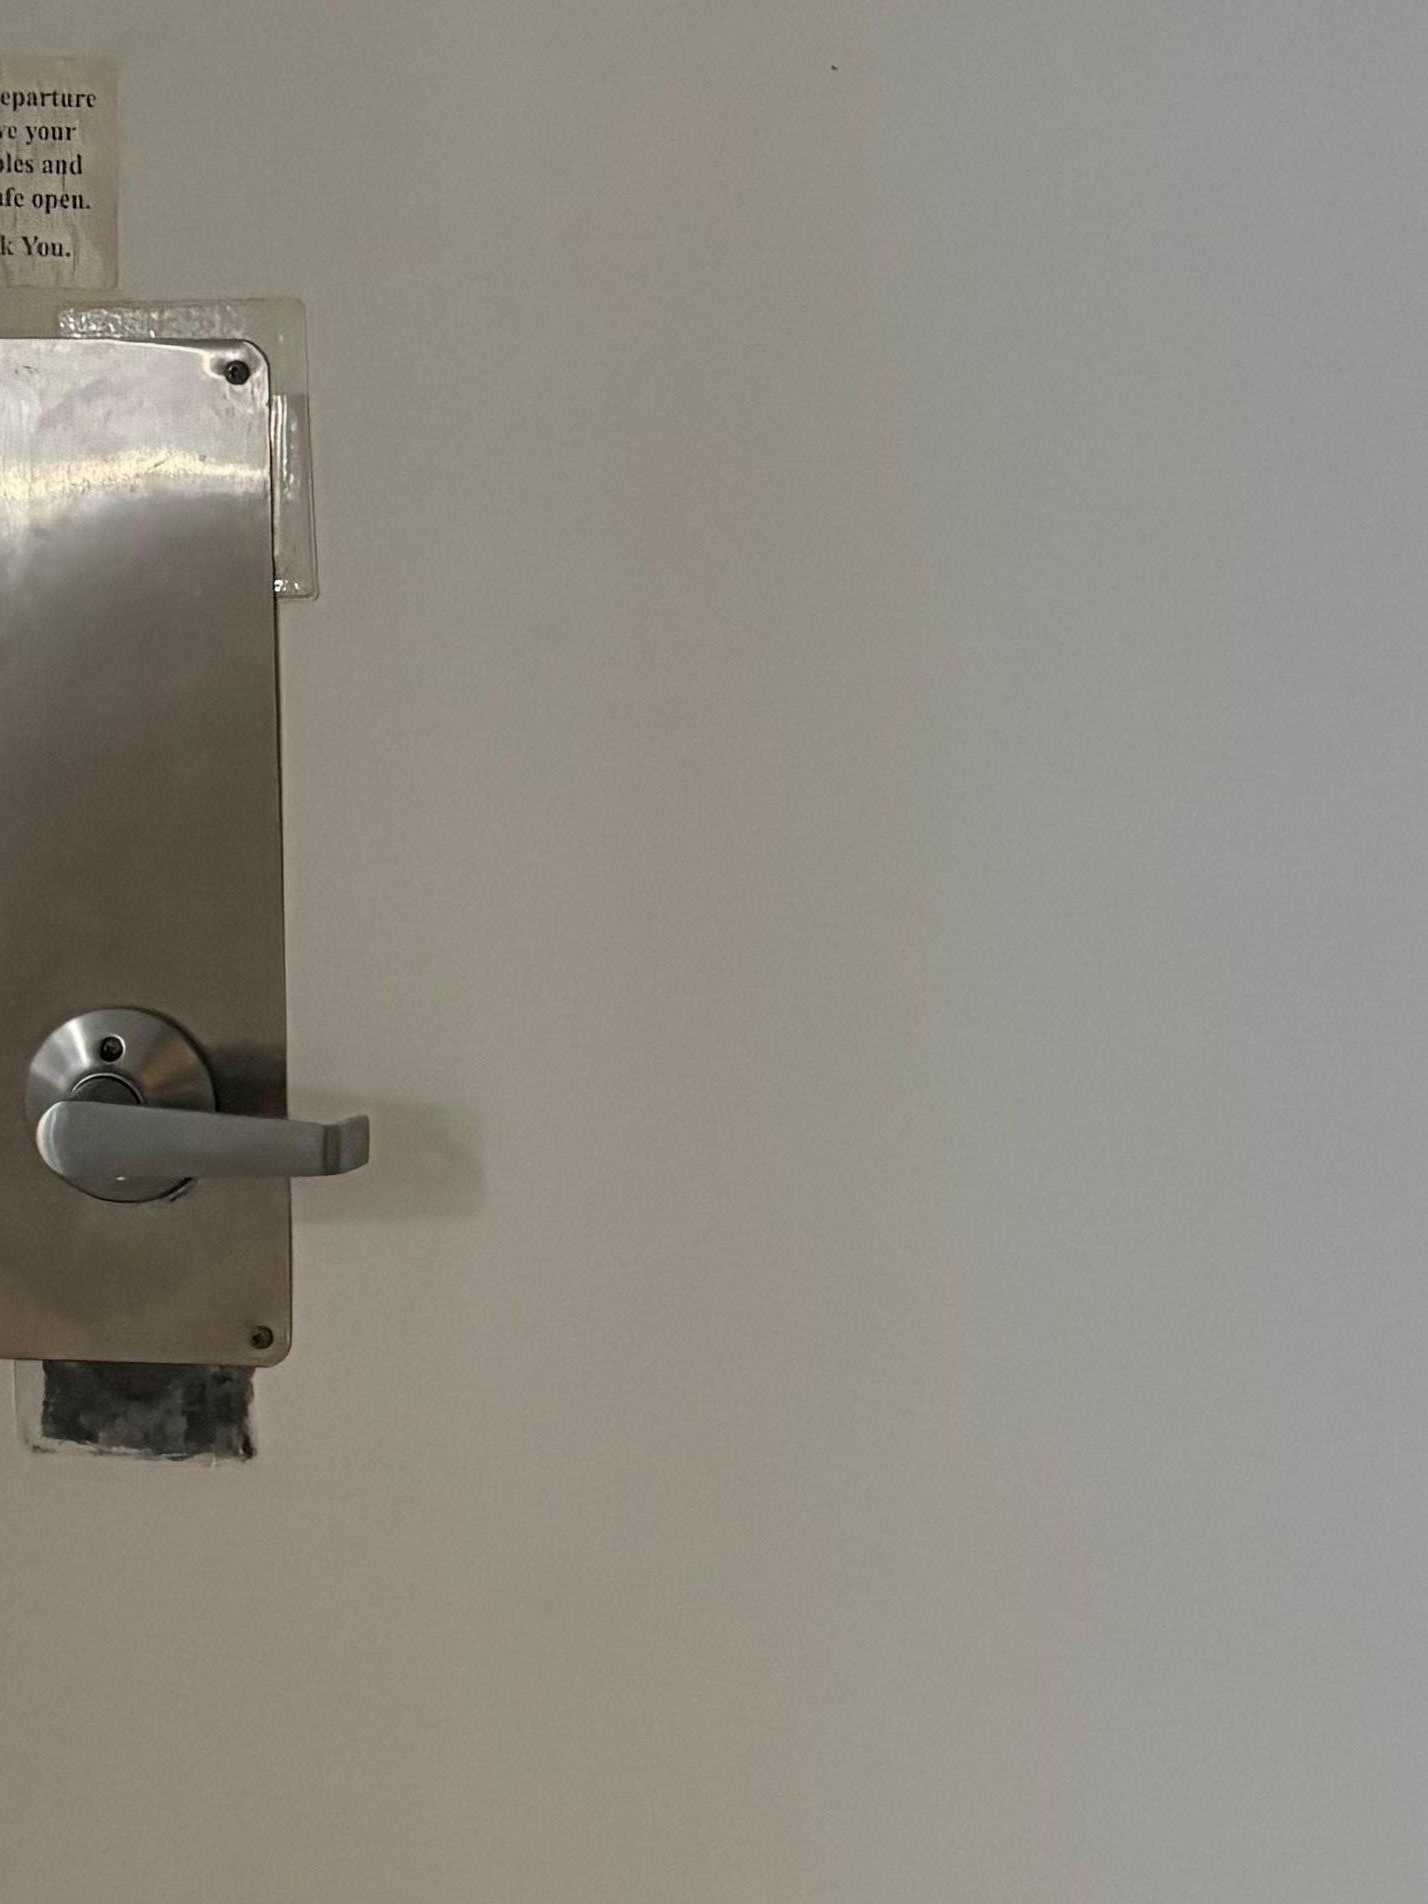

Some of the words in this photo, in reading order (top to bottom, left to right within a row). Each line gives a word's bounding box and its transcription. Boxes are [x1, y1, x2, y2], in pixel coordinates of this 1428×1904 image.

[25, 124, 77, 146] your
[42, 153, 83, 176] and
[31, 193, 91, 215] open.
[21, 235, 71, 258] You.
